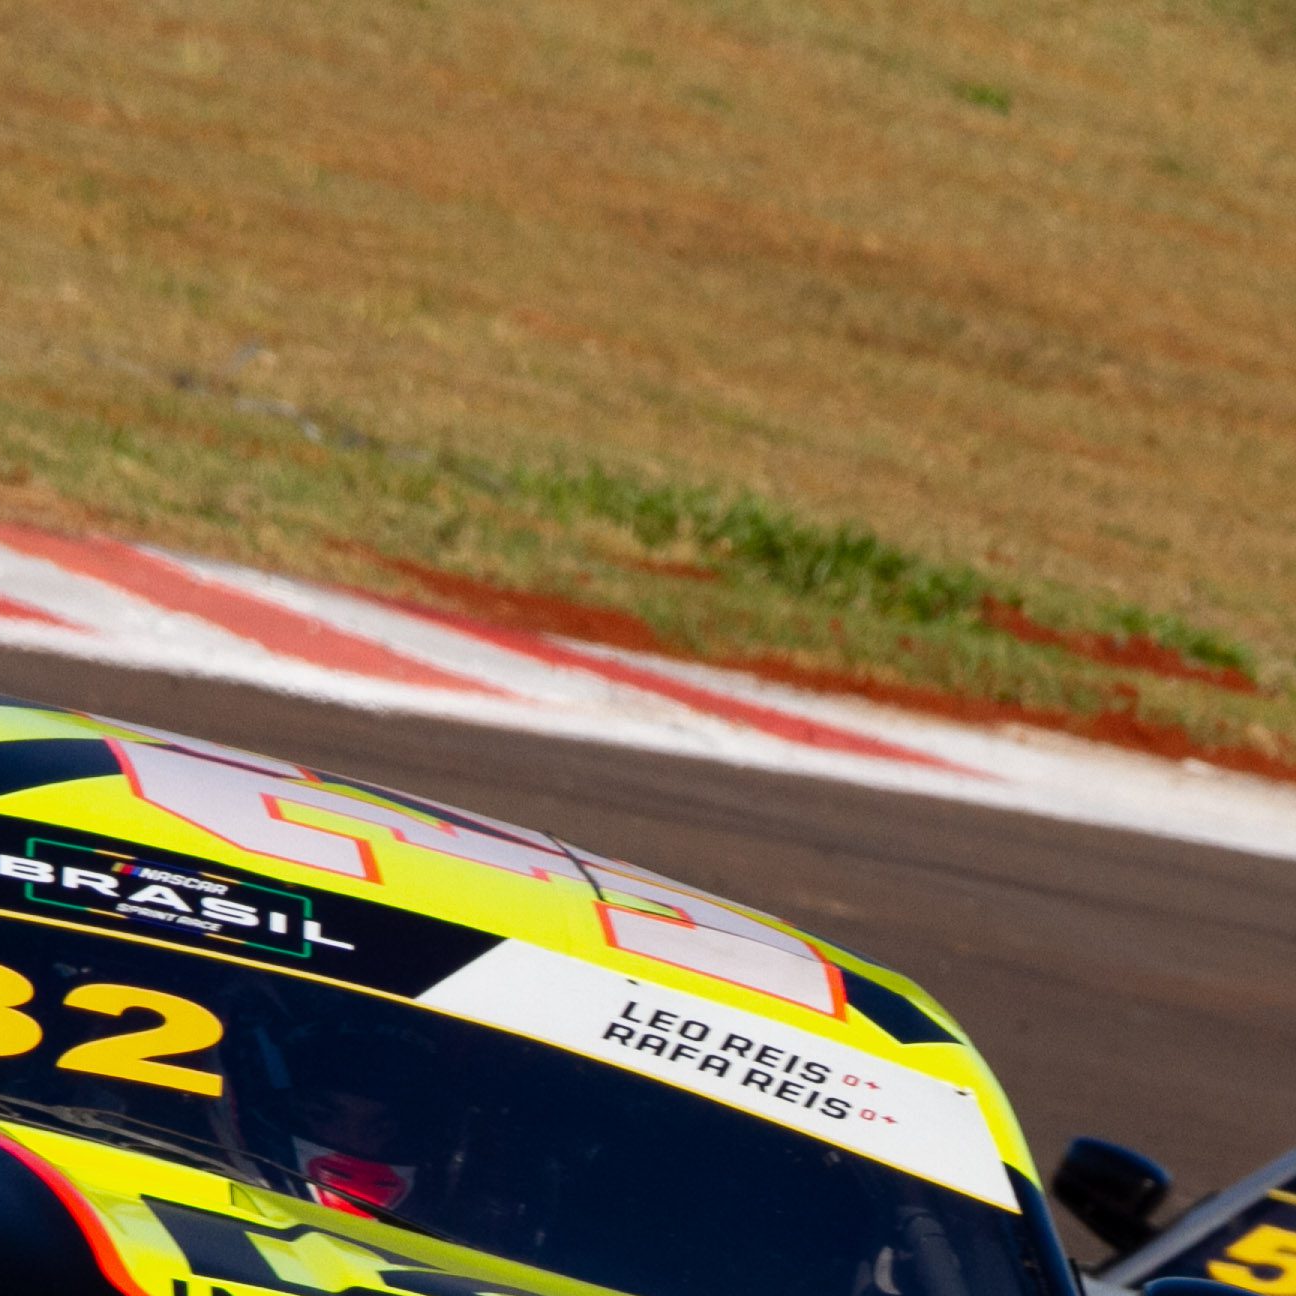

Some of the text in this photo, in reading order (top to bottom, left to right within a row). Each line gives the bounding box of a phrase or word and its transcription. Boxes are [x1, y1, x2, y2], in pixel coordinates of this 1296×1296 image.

[138, 866, 229, 896] NASCAR
[602, 1021, 732, 1079] RAFA
[741, 1067, 853, 1121] REIS
[619, 1001, 711, 1043] LEO
[720, 1032, 833, 1085] REIS
